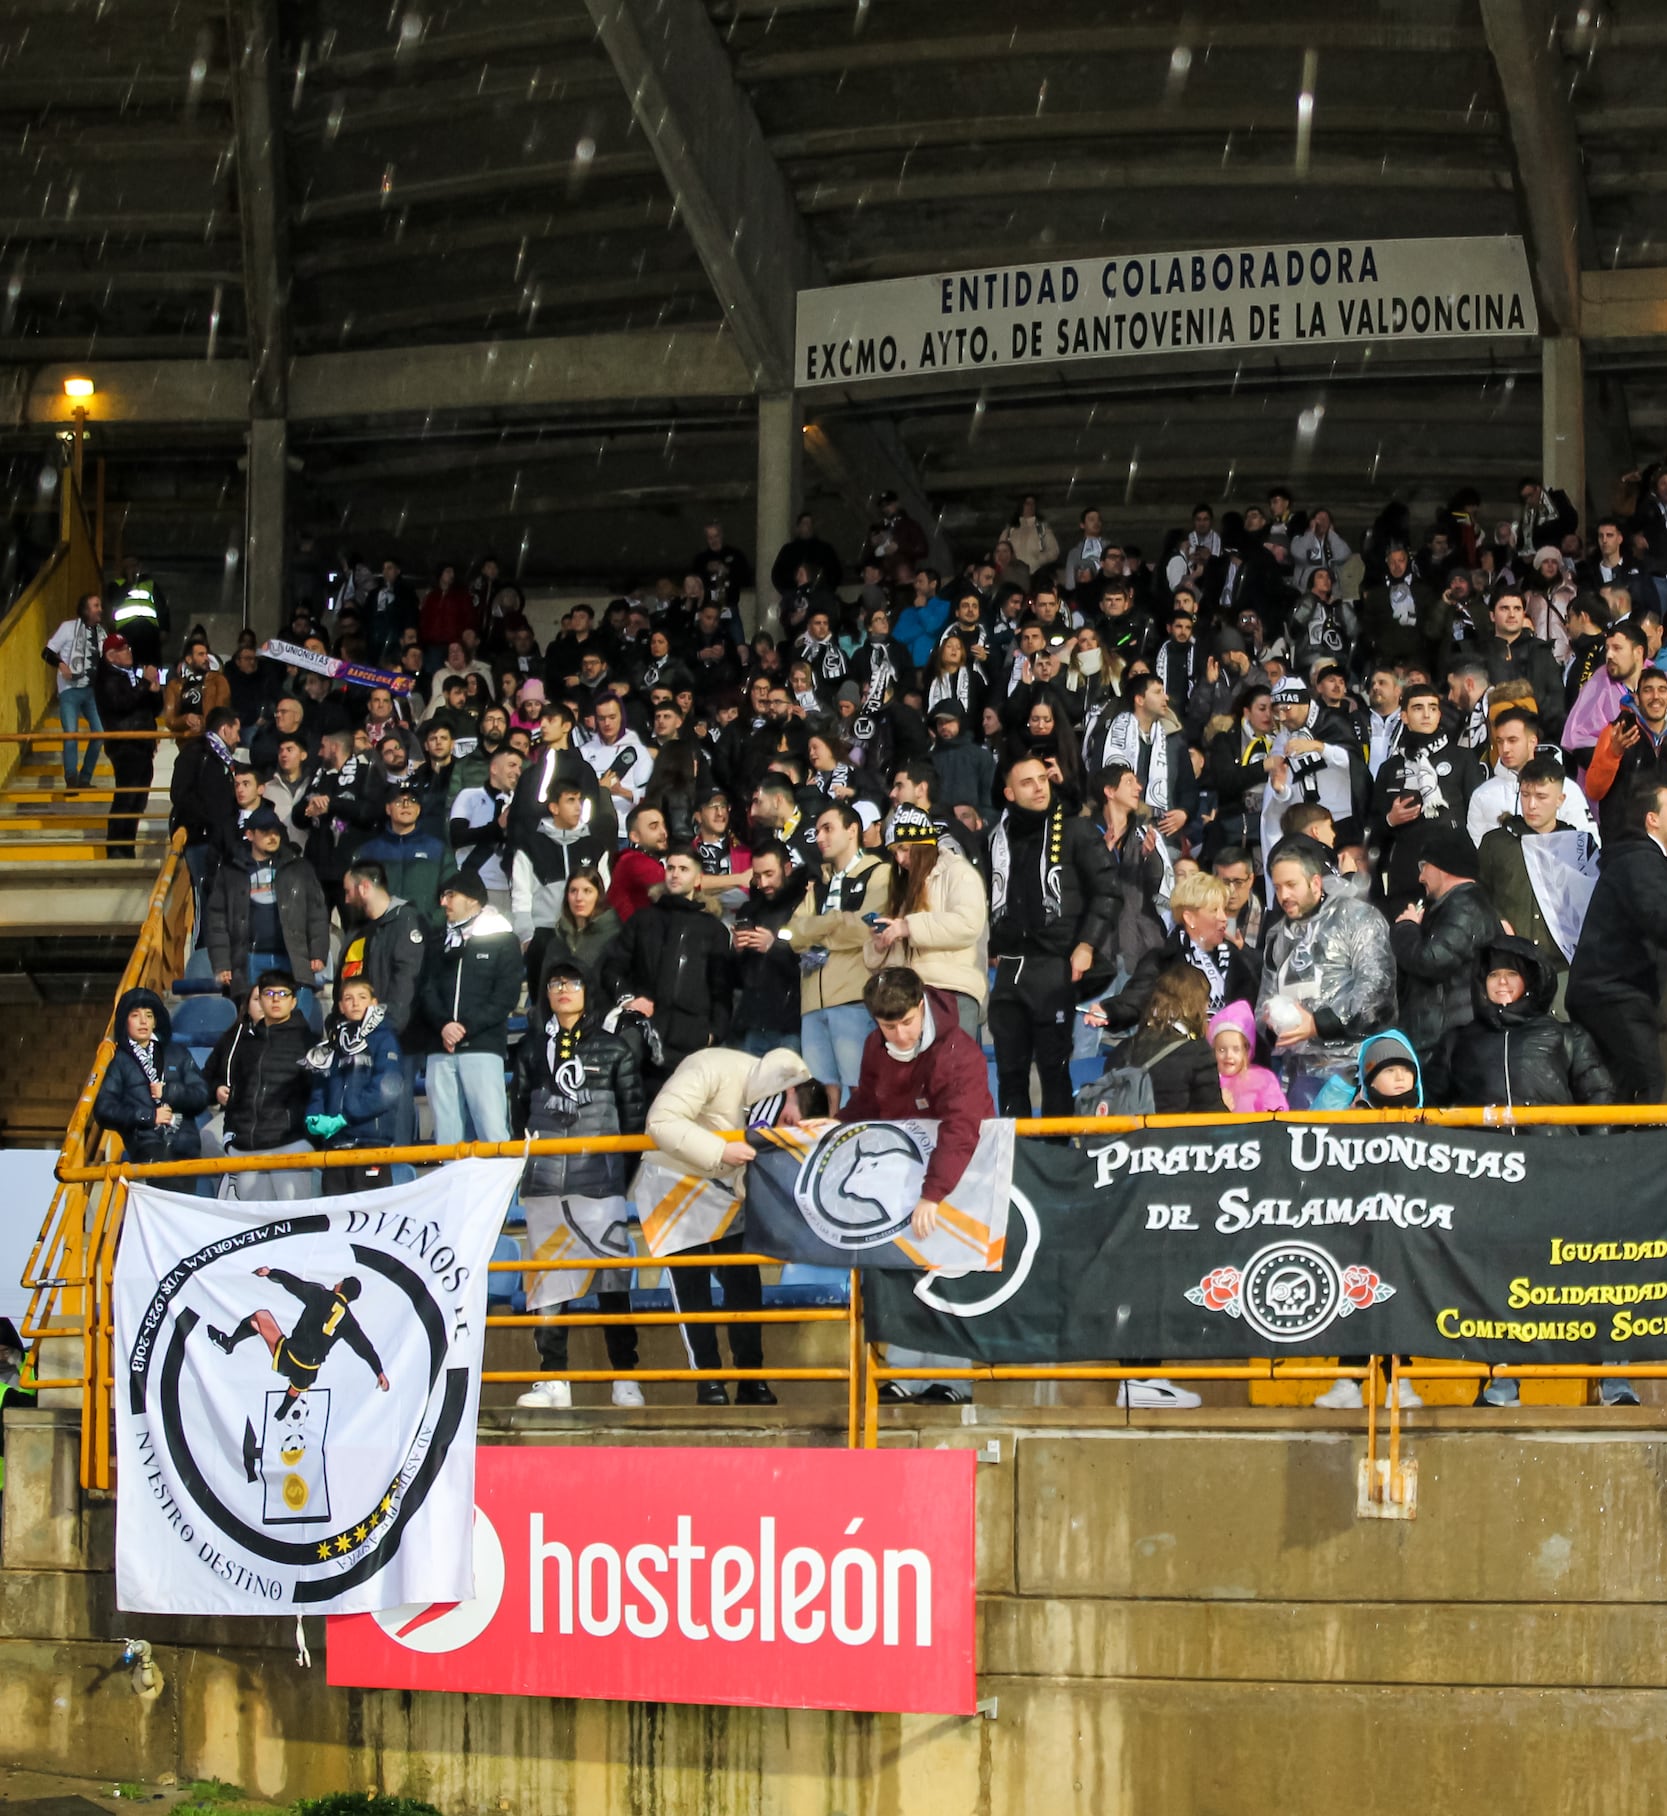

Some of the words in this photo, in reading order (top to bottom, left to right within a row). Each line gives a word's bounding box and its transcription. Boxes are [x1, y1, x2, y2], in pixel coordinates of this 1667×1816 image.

[941, 266, 1079, 314] ENTIDAD
[1101, 247, 1379, 298] COLABORADORA
[806, 338, 906, 381] EXCMO.
[920, 326, 999, 369] AYTO.
[1011, 318, 1042, 359] DE
[1057, 302, 1235, 355] SANTOVENIA
[1249, 299, 1280, 340] DE
[1295, 298, 1325, 338] LA
[1338, 293, 1526, 335] VALDONCINA
[285, 644, 329, 666] UNIONISTAS
[529, 1512, 932, 1647] hosteleón
